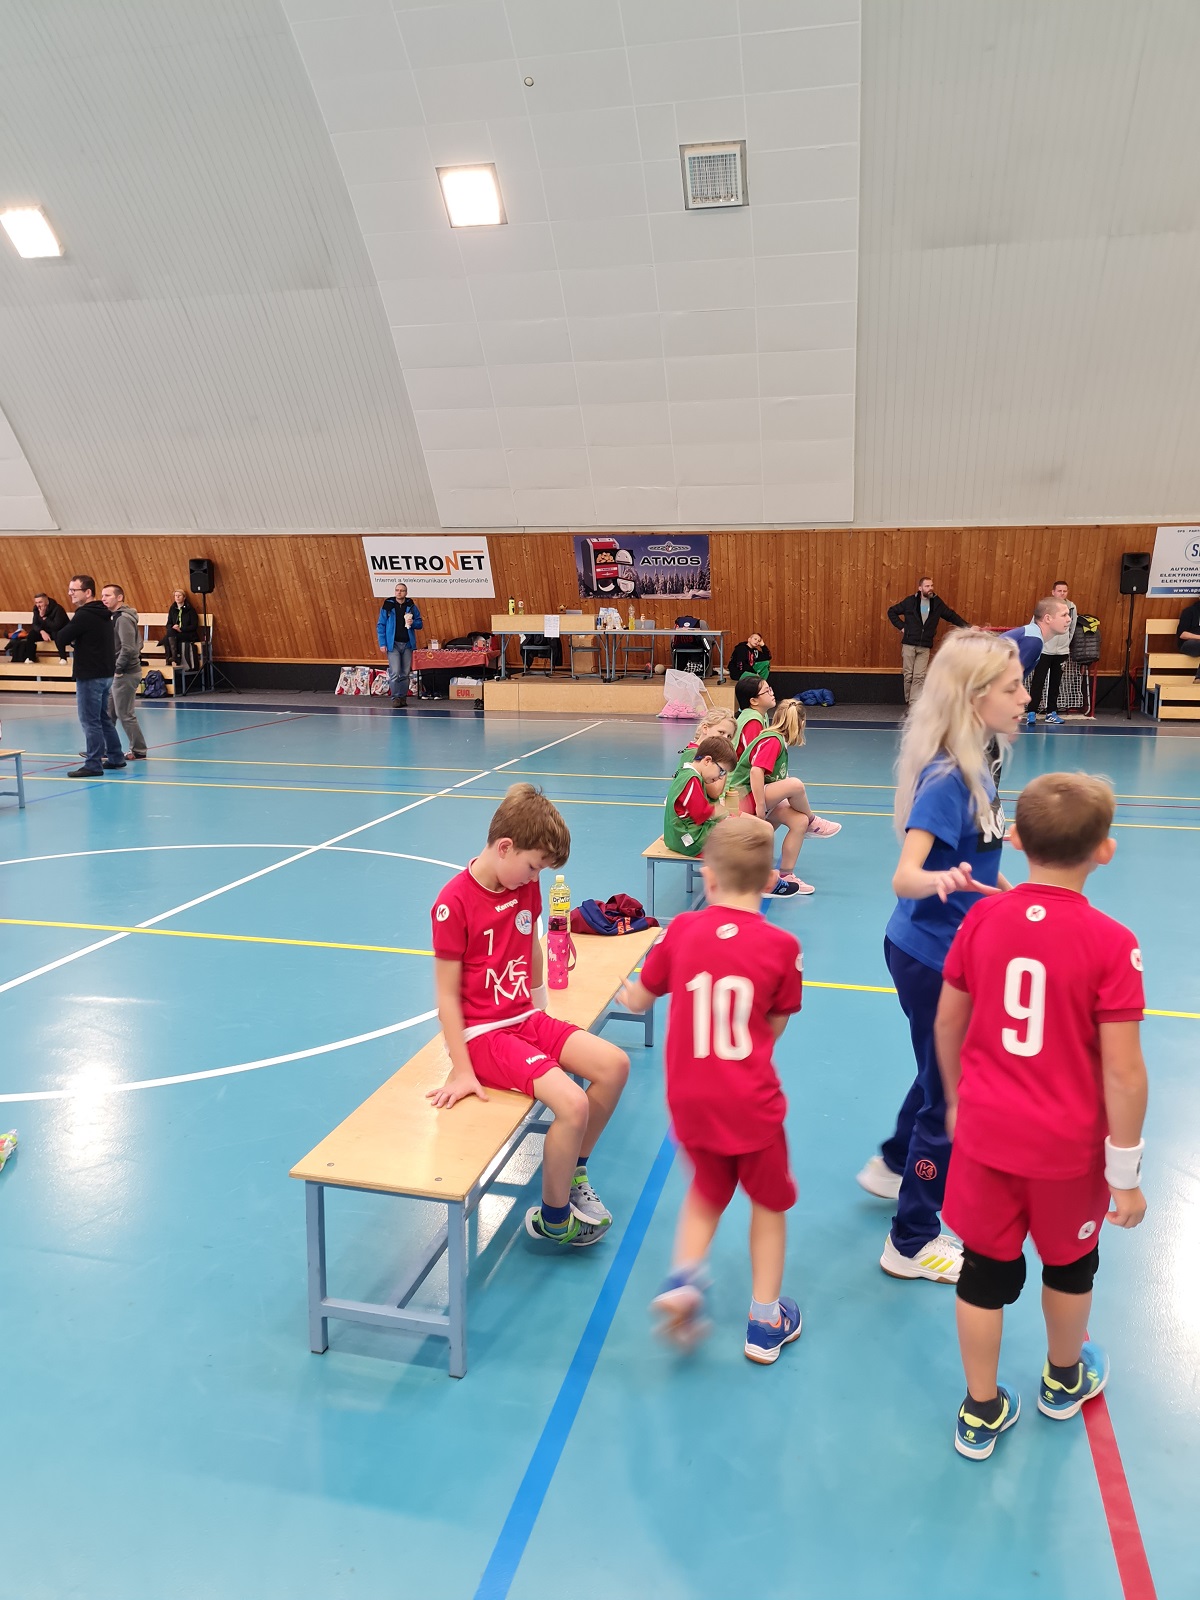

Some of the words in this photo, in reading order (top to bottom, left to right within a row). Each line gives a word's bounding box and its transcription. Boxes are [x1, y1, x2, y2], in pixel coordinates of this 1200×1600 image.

[1191, 543, 1200, 557] S
[370, 554, 486, 573] METRONET
[640, 556, 701, 567] ATMOS
[449, 576, 489, 584] profesionálně
[494, 898, 519, 913] Kempa
[1001, 957, 1047, 1057] 9
[685, 970, 755, 1061] 10
